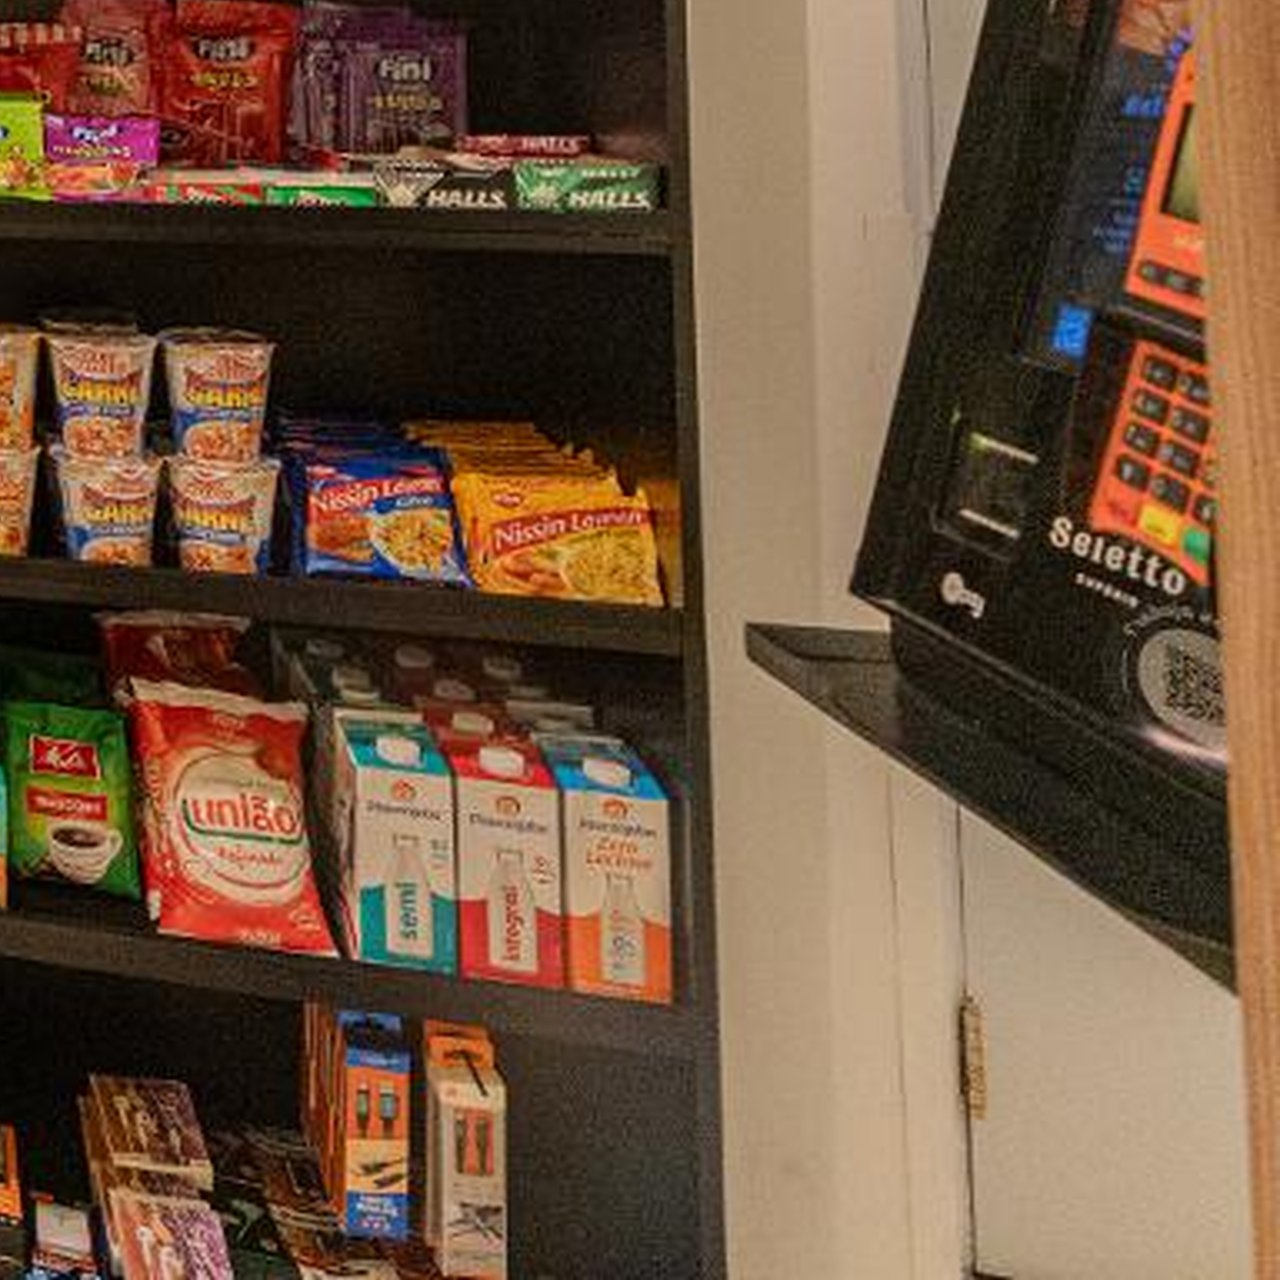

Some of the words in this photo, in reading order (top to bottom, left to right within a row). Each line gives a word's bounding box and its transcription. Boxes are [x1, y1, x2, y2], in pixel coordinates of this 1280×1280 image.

[427, 188, 508, 208] HALLS
[568, 188, 652, 210] HALLS
[308, 487, 380, 513] Nissin
[495, 519, 566, 548] Nissin
[1048, 515, 1187, 597] Seletto
[188, 794, 302, 836] união
